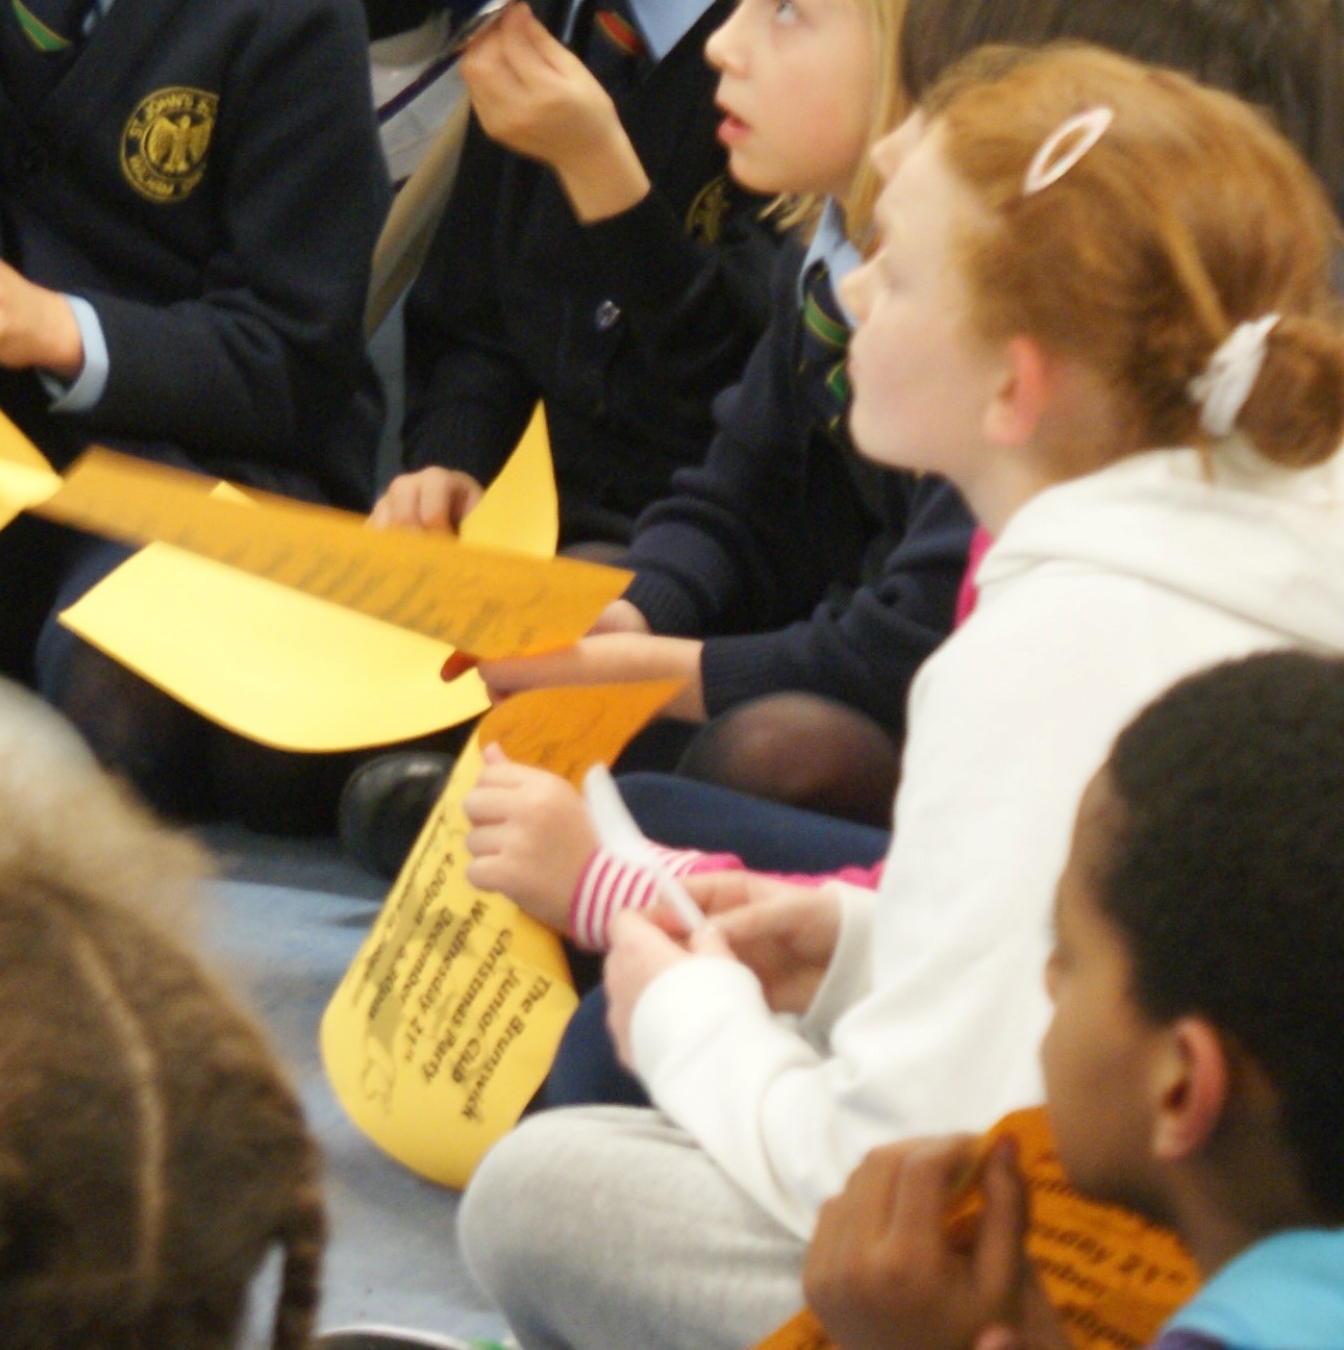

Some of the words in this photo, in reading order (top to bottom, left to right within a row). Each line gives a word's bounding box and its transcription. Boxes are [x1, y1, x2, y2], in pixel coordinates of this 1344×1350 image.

[400, 906, 453, 1003] December
[419, 899, 488, 1014] Wednesday
[452, 928, 512, 1027] Christmas
[521, 975, 552, 1014] The
[477, 968, 521, 1034] Junior
[422, 1029, 457, 1083] Party
[452, 1038, 482, 1083] Club
[462, 1015, 527, 1122] Brunswick
